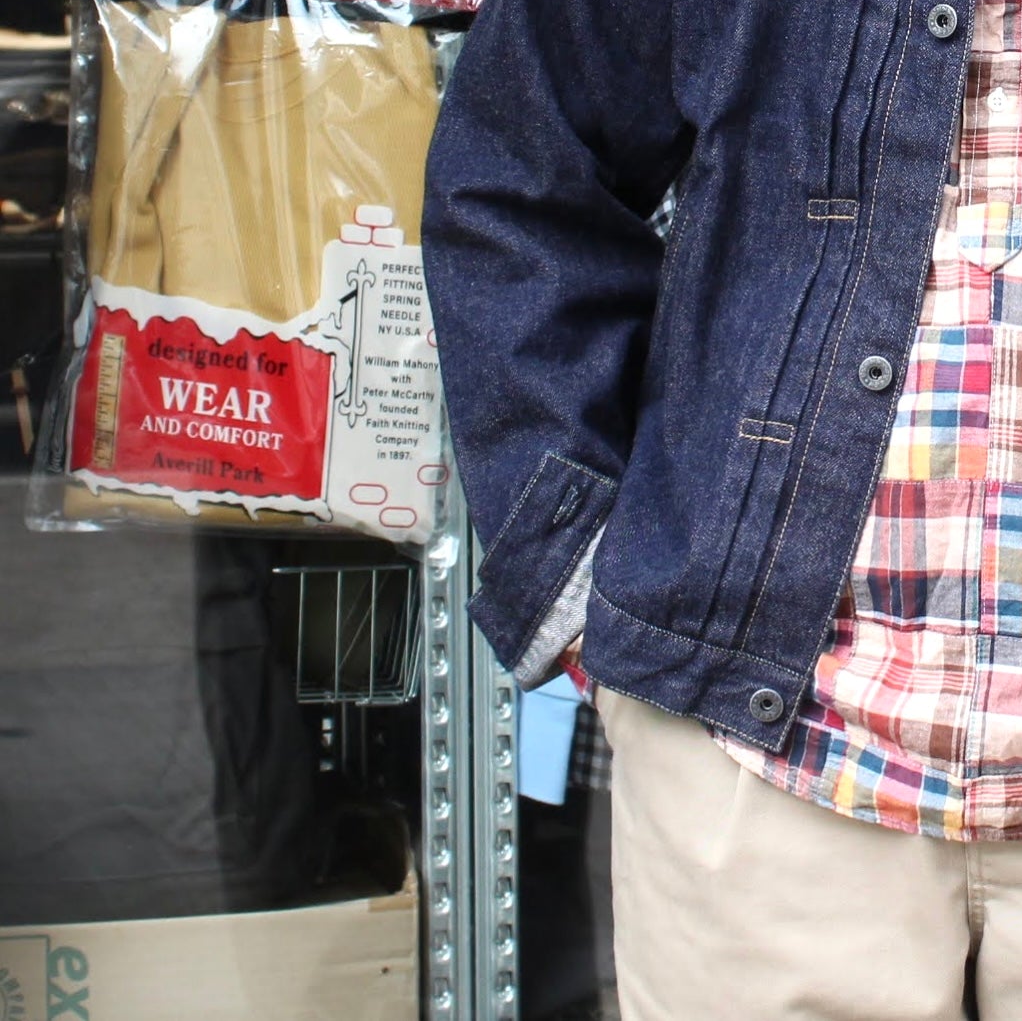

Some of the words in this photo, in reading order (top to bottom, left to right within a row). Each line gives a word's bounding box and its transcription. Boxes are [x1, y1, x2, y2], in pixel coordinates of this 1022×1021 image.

[383, 279, 423, 291] FITTING
[383, 294, 421, 306] SPRING
[381, 309, 421, 322] NEEDLE
[378, 325, 392, 335] NY
[148, 337, 248, 370] designed
[257, 352, 289, 376] for
[364, 356, 399, 368] William
[402, 358, 439, 371] Mahony
[391, 375, 412, 384] with
[158, 376, 272, 425] WEAR
[363, 387, 388, 397] Peter
[391, 389, 435, 402] McCarthy
[379, 403, 419, 415] founded
[366, 418, 389, 428] Faith
[392, 420, 430, 433] Knitting
[140, 415, 181, 435] AND
[186, 421, 284, 451] COMFORT
[375, 434, 419, 447] Company
[377, 450, 386, 459] in
[153, 452, 214, 476] Averill
[220, 460, 264, 483] Park
